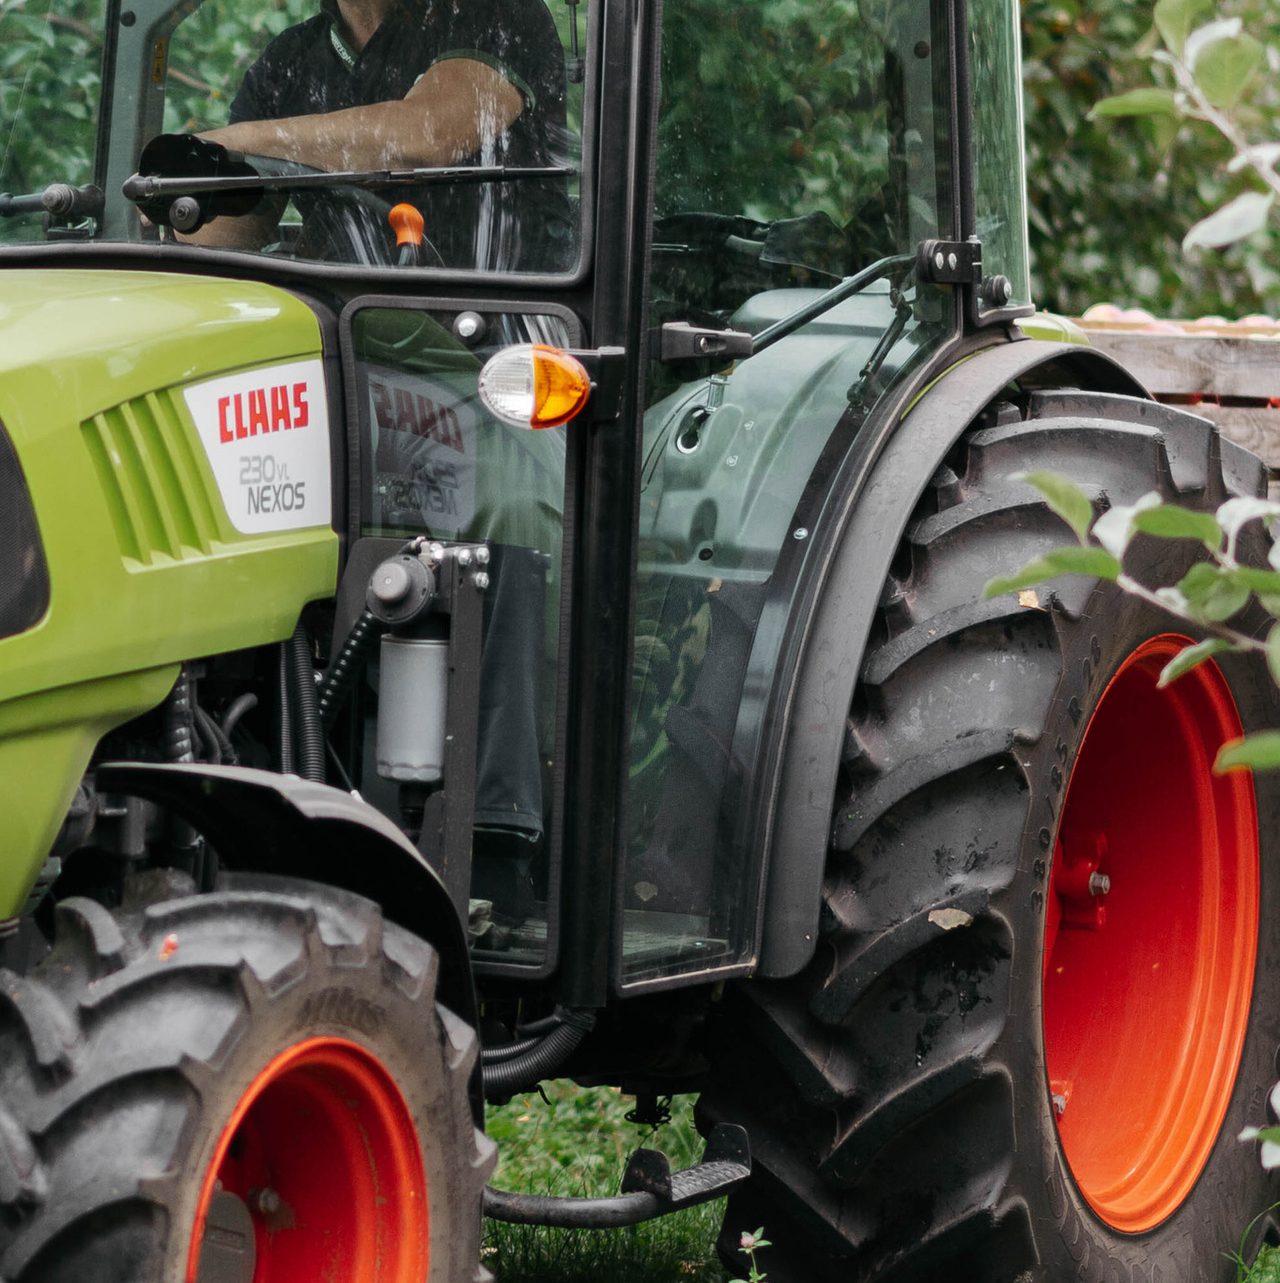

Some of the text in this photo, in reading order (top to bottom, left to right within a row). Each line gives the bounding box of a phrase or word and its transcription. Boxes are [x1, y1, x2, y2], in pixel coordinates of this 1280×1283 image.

[218, 382, 309, 444] CLAAS
[239, 454, 276, 486] 230
[247, 482, 306, 515] NEXOS
[1030, 735, 1068, 915] 380/85
